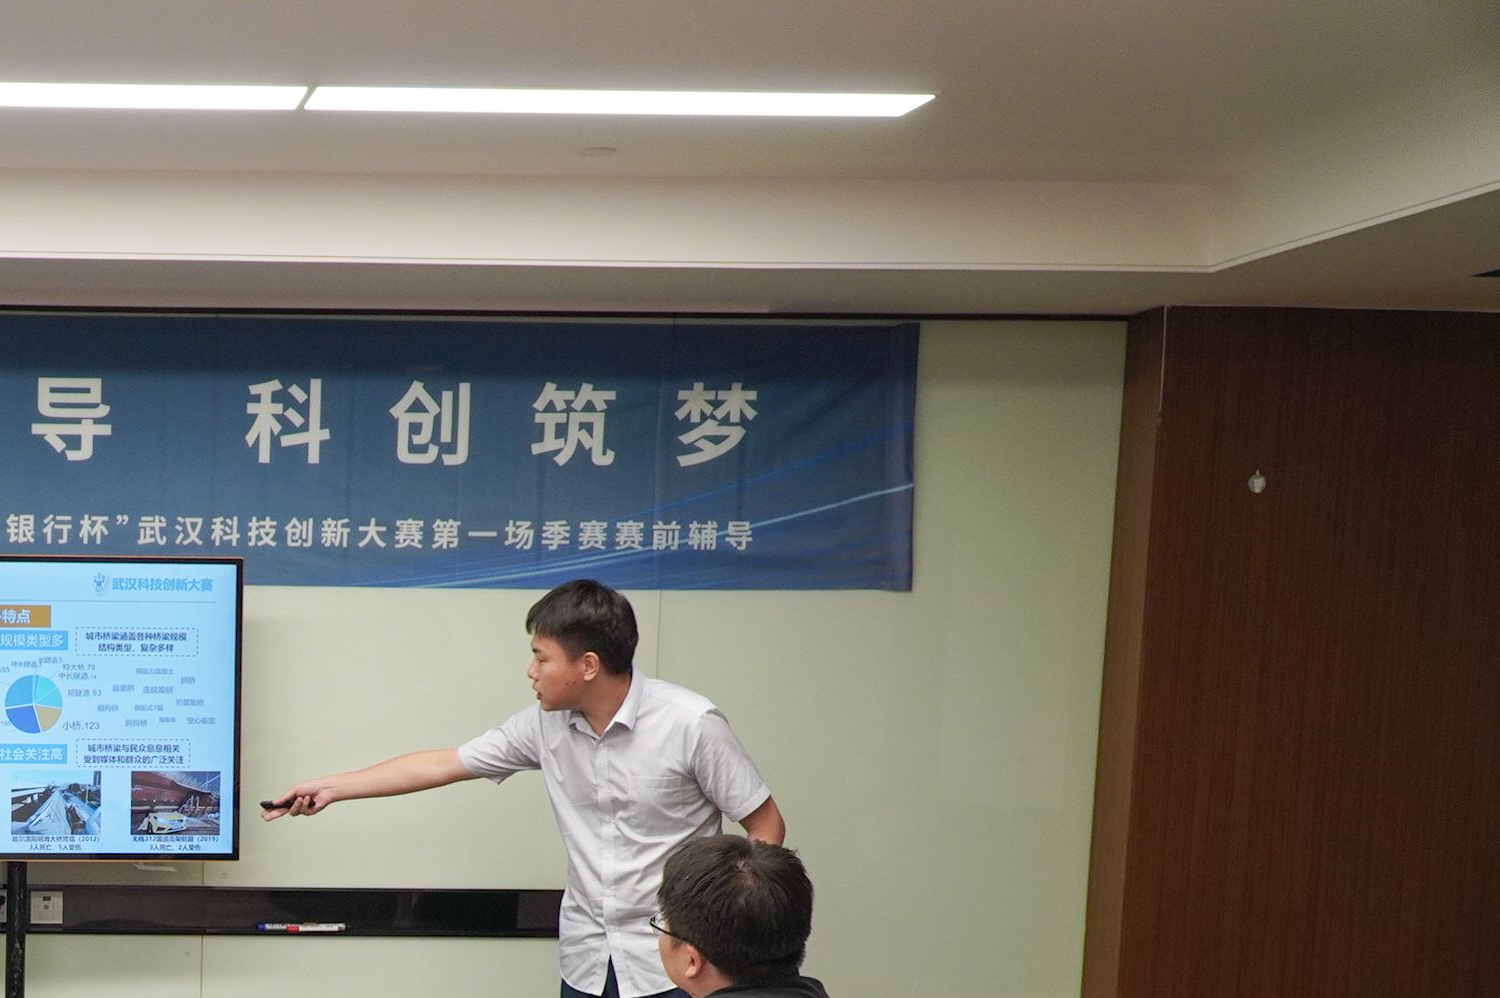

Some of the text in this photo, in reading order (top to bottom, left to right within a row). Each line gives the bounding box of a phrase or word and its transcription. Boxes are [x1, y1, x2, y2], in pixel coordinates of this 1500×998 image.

[245, 378, 758, 467] 科创筑梦
[112, 577, 214, 592] 武汉科技创新大赛
[0, 633, 64, 648] 规模类型多
[0, 747, 63, 762] 社会关注高
